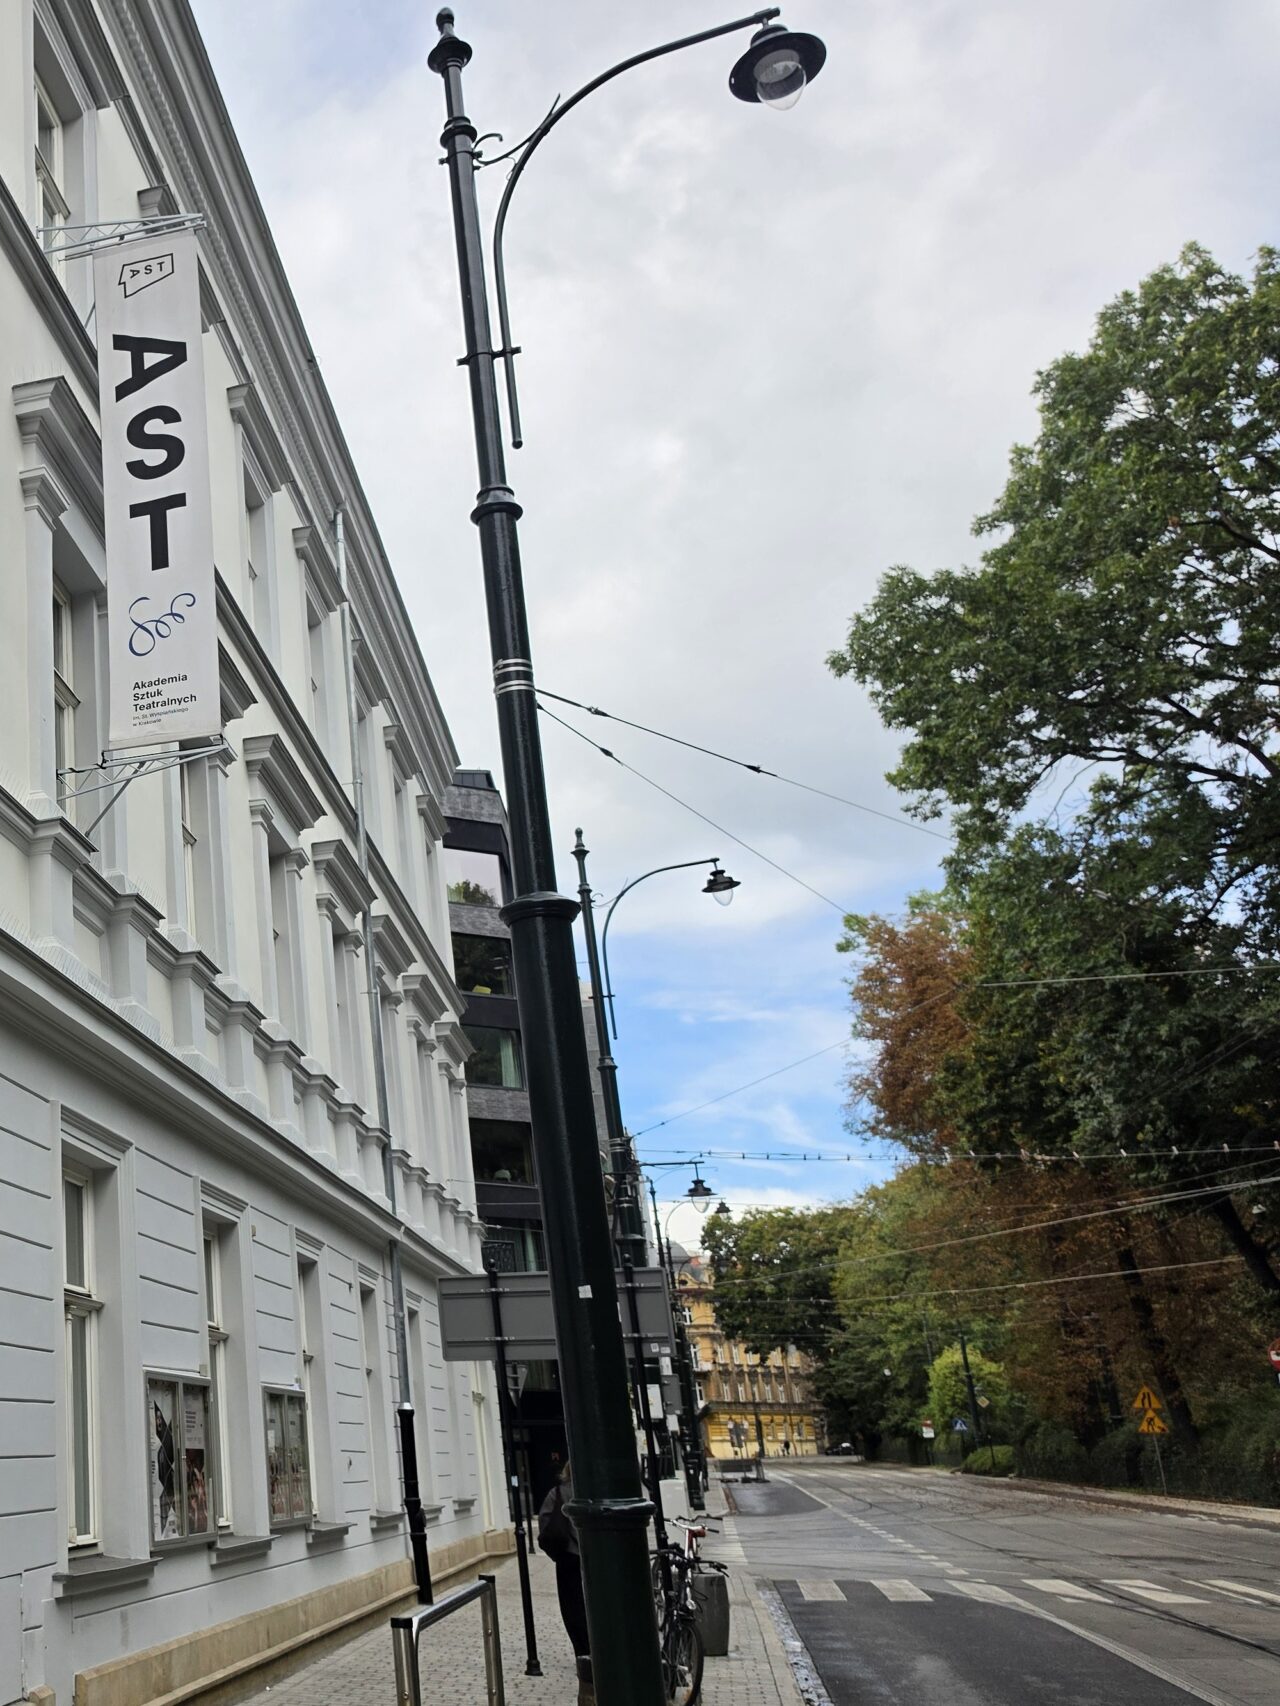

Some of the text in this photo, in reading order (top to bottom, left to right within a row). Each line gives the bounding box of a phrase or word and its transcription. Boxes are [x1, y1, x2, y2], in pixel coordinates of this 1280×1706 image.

[130, 261, 165, 279] AST
[112, 334, 187, 571] AST
[133, 674, 188, 691] Akademia
[133, 689, 163, 702] Sztuk
[133, 694, 197, 712] Teatralnych
